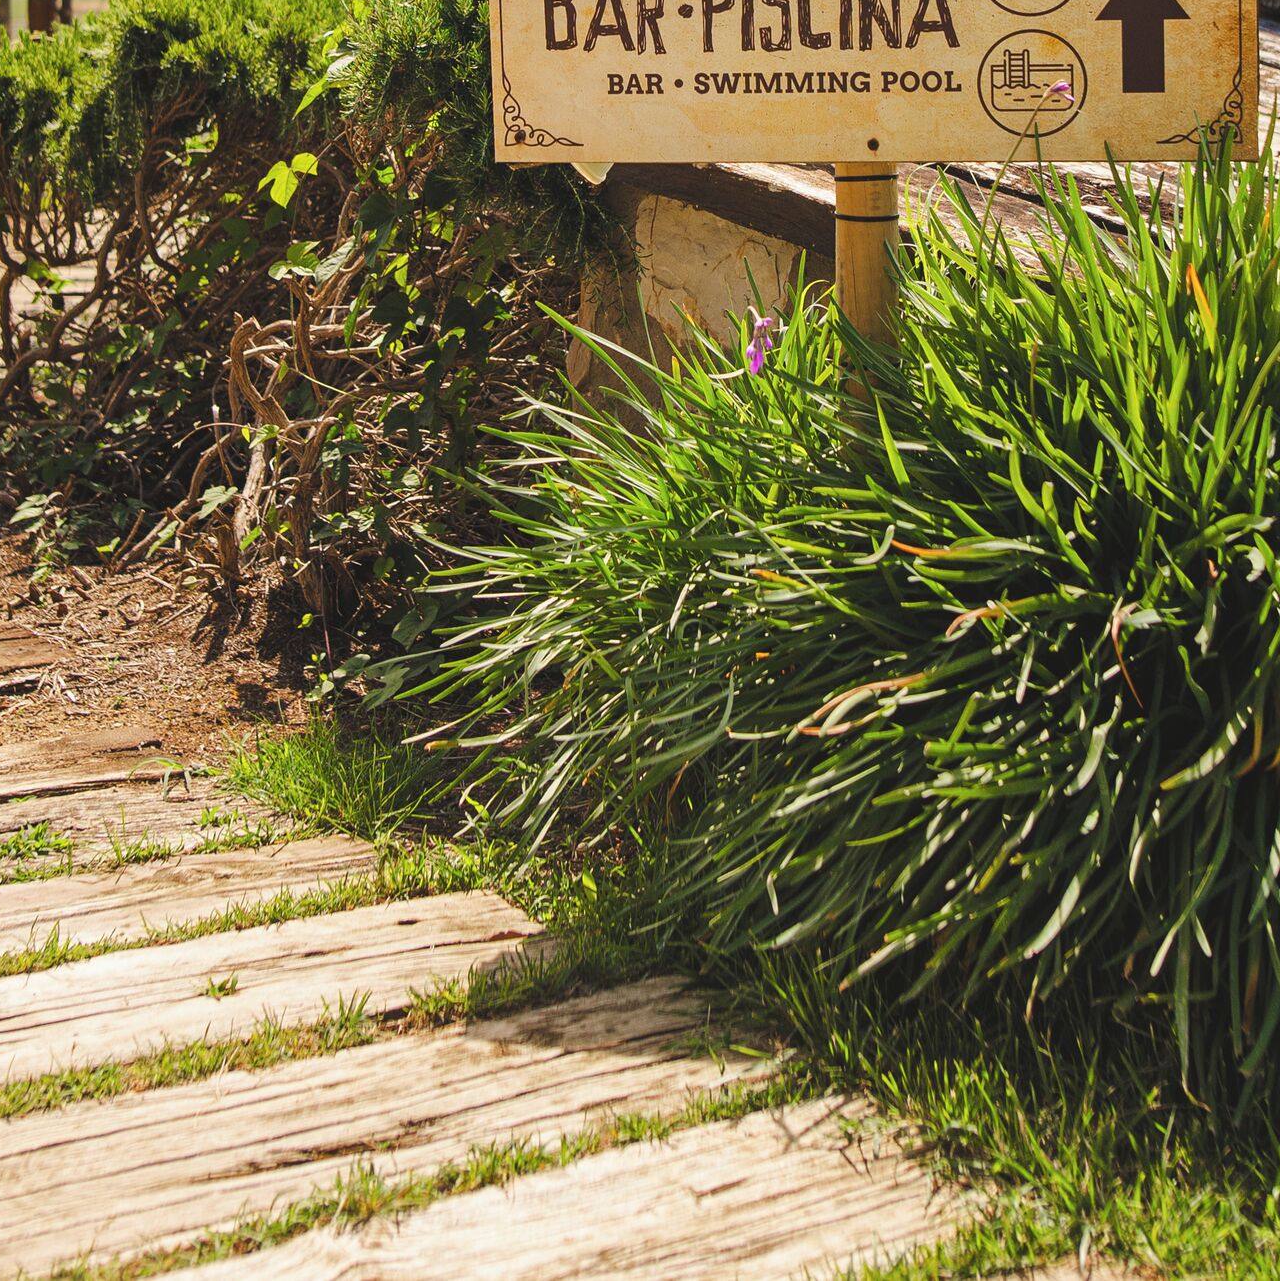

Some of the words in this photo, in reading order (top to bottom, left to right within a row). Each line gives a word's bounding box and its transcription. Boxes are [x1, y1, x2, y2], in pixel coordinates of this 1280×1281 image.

[606, 73, 664, 96] BAR
[693, 71, 871, 95] SWIMMING
[880, 70, 963, 94] POOL
